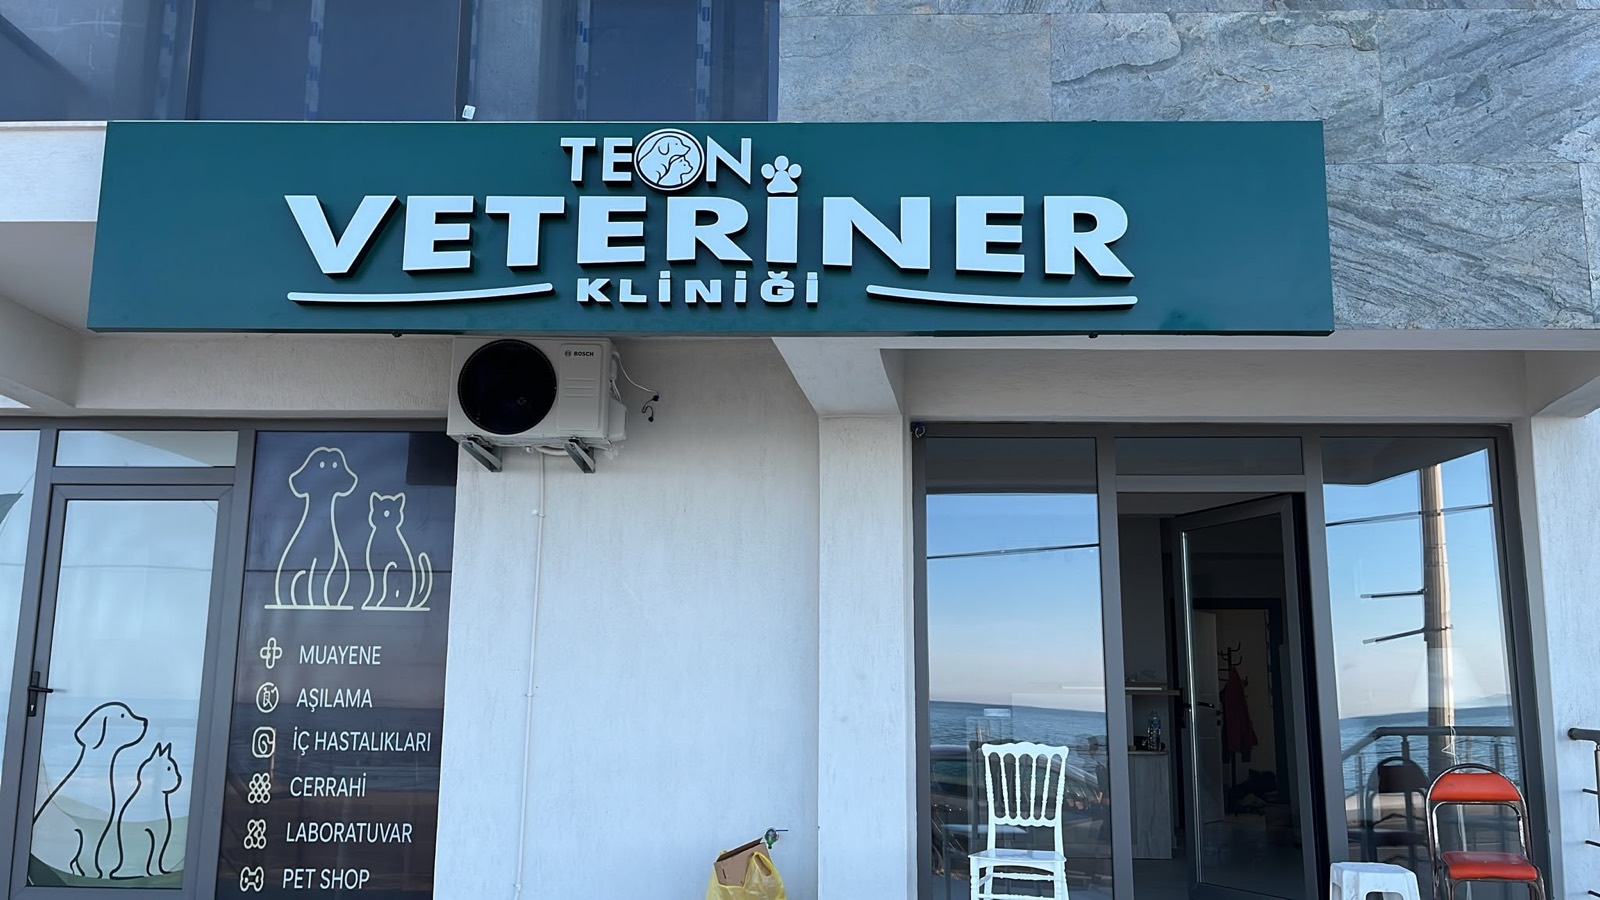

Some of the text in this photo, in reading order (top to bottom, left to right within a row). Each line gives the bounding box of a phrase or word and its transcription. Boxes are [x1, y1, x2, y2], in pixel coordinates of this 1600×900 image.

[299, 645, 382, 665] MUAYENE
[296, 688, 373, 713] AŞILAMA
[293, 726, 432, 756] İÇ HASTALIKLARI
[290, 772, 367, 797] CERRAHİ
[286, 822, 413, 844] LABORATUVAR
[282, 868, 370, 889] PET SHOP
